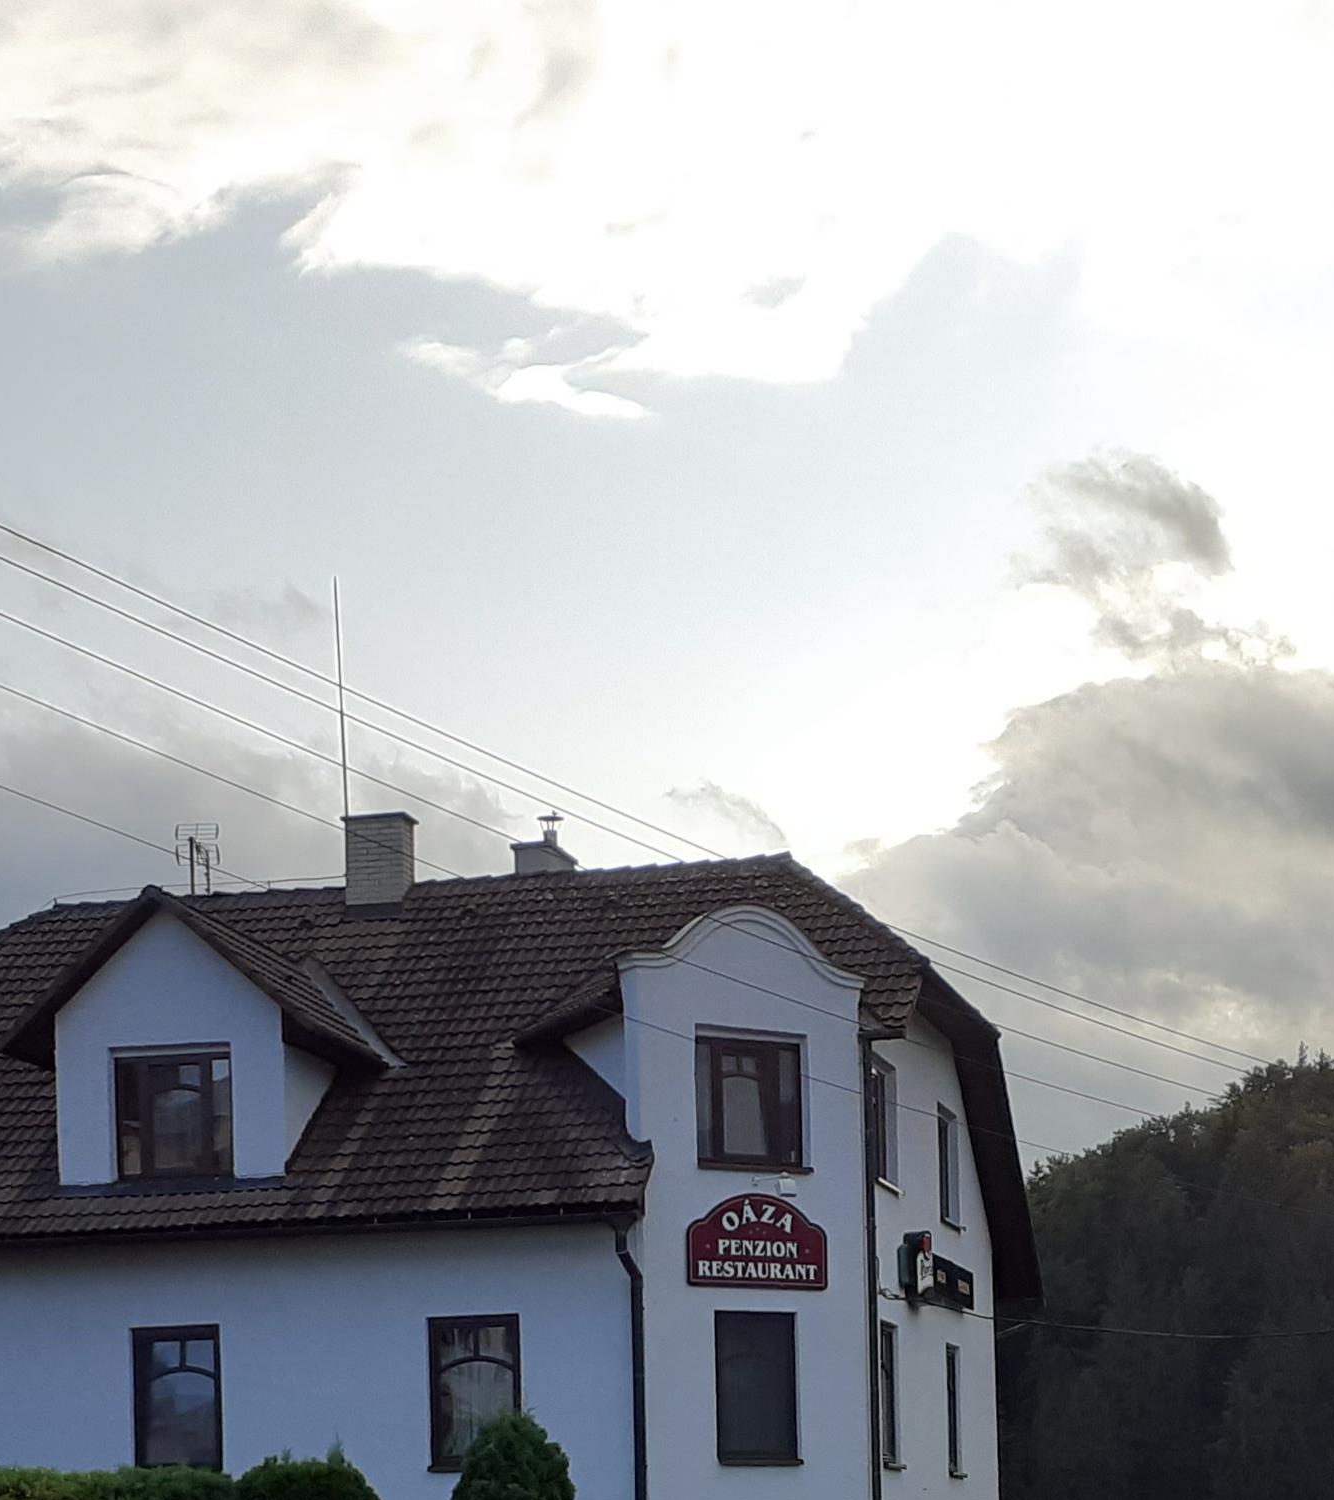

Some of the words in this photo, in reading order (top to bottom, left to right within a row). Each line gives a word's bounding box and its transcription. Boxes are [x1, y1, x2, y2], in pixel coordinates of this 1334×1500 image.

[721, 1199, 794, 1235] OÁZA
[717, 1238, 799, 1259] PENZION
[698, 1260, 818, 1280] RESTAURANT
